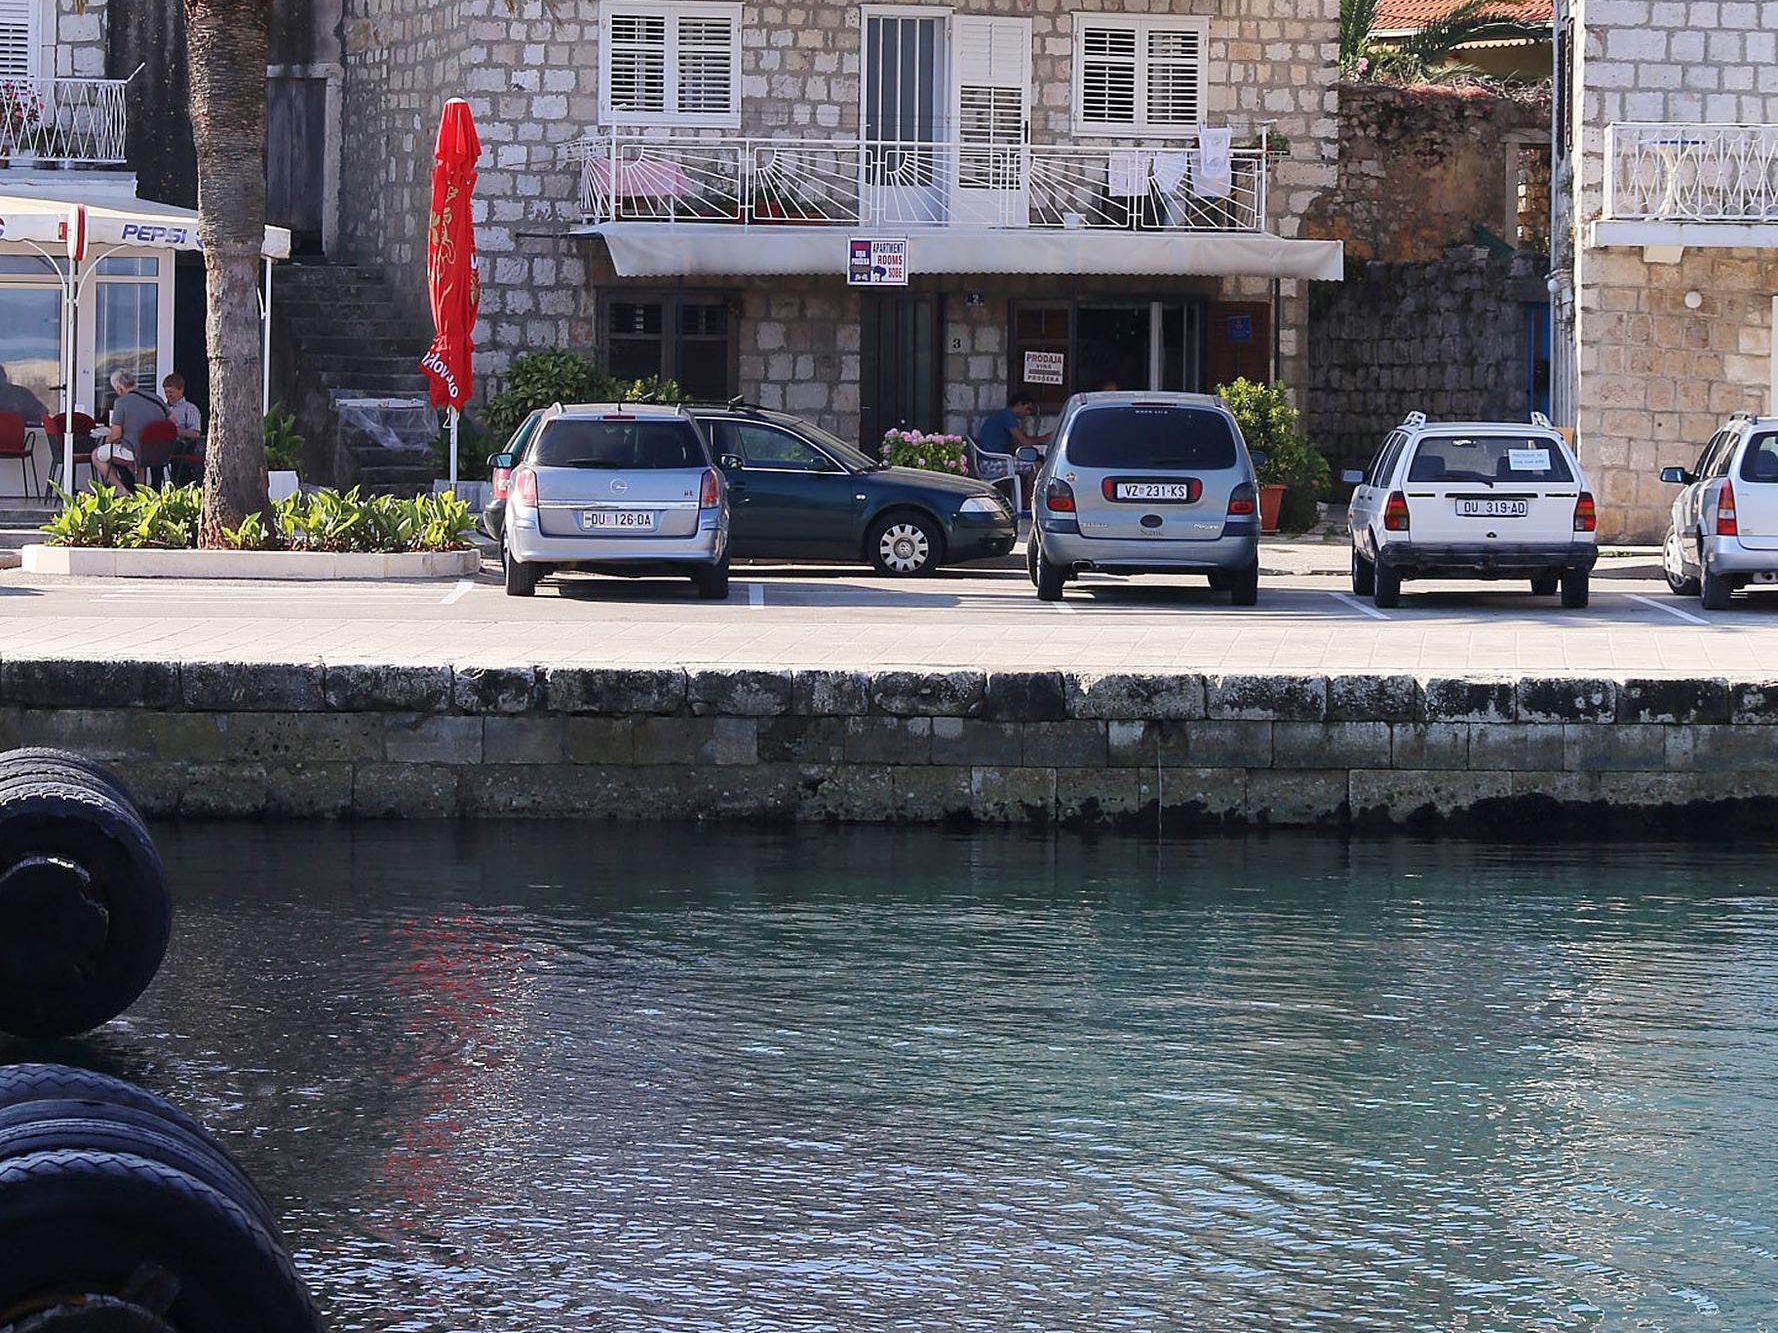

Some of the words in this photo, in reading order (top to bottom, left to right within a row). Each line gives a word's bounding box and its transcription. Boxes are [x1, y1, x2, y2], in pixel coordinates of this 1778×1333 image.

[877, 254, 903, 266] ROOMS
[953, 337, 961, 349] 3
[1026, 353, 1063, 364] PRODAJA
[1124, 485, 1138, 497] VZ
[1145, 485, 1185, 497] 231-KS
[1464, 501, 1479, 513] DU
[591, 513, 606, 525] DU
